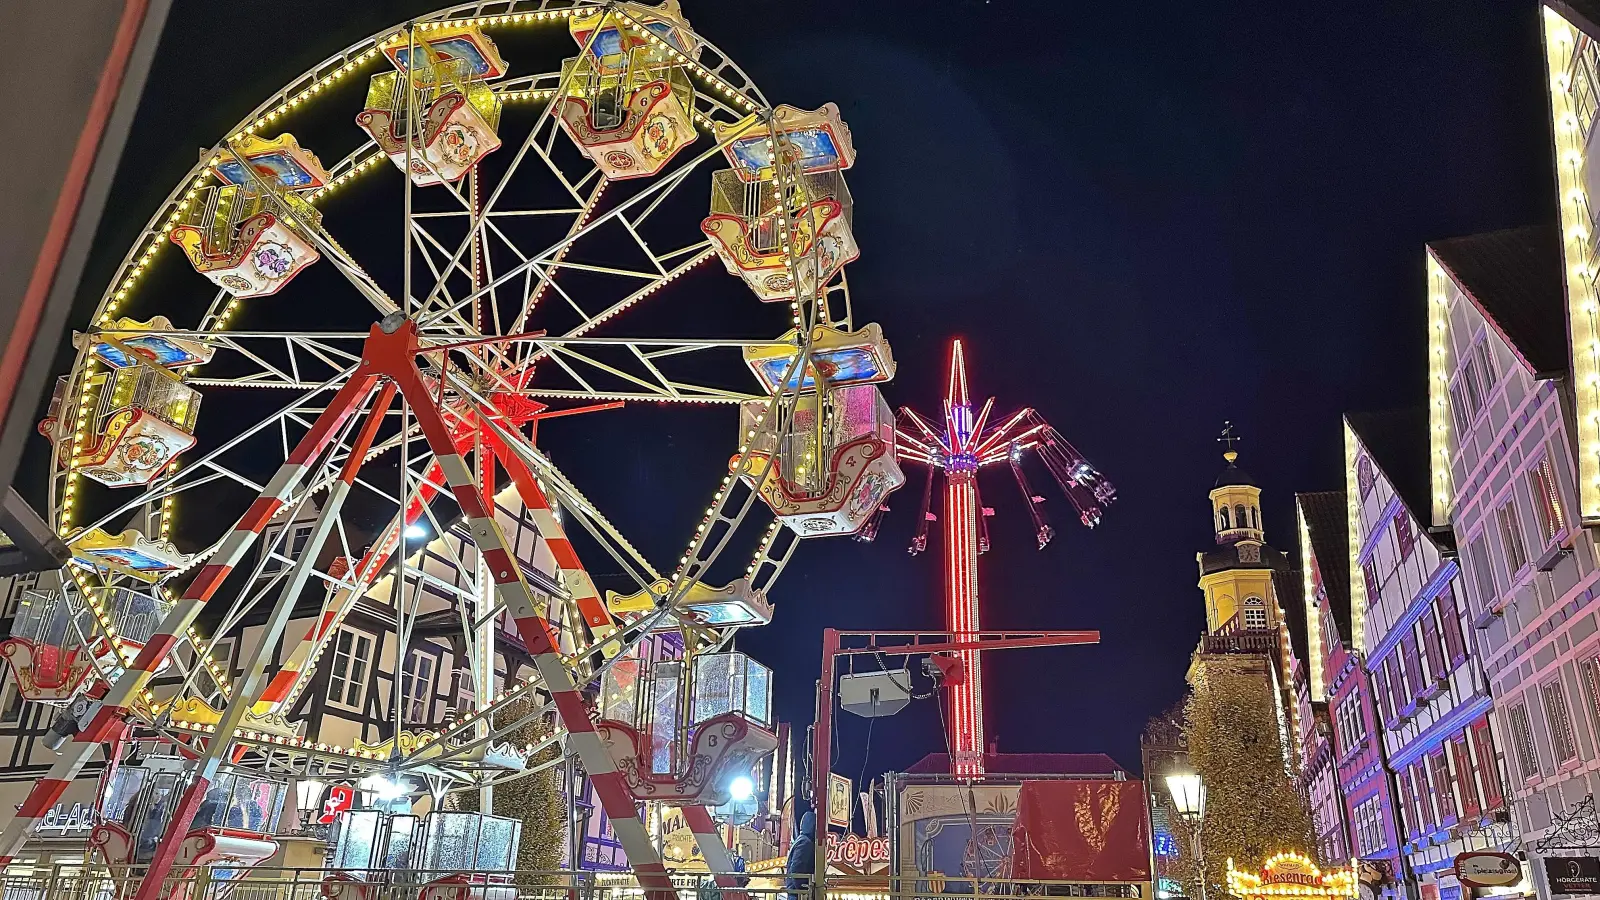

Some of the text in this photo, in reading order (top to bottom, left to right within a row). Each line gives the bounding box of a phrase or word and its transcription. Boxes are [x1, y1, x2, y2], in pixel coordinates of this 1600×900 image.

[640, 97, 648, 107] 6
[438, 107, 445, 117] 7
[247, 227, 255, 236] 8
[114, 421, 121, 431] 9
[845, 455, 857, 468] 4
[826, 832, 890, 868] Crêpes
